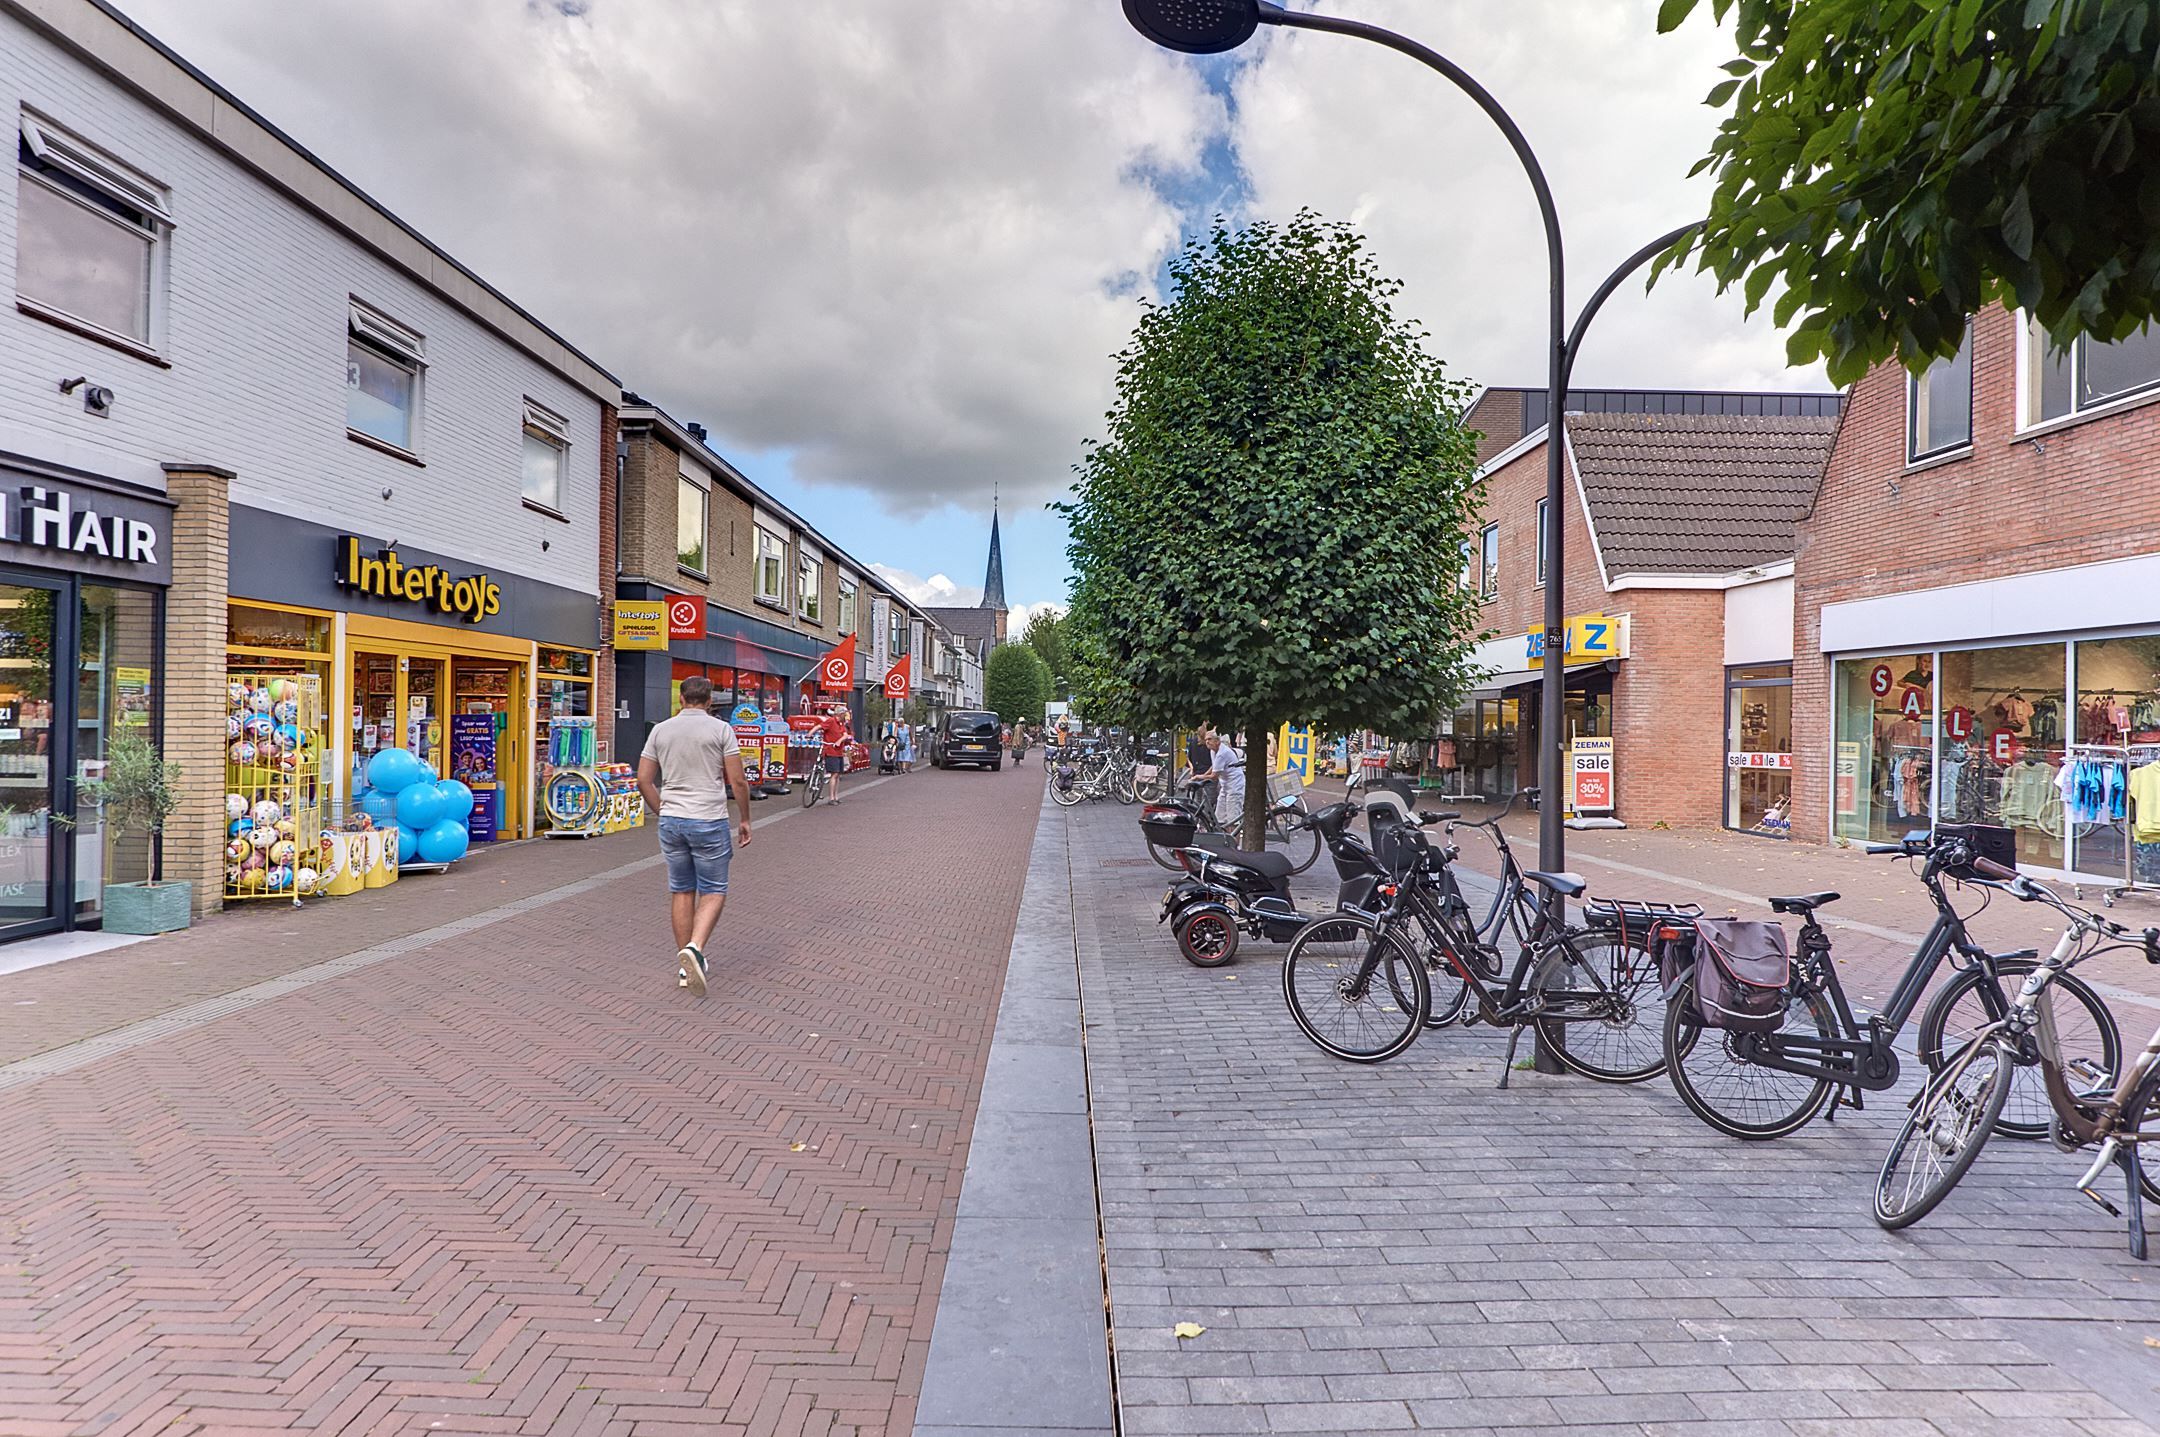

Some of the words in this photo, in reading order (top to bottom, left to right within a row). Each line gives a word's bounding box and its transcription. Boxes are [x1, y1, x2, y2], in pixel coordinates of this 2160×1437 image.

[32, 486, 158, 564] HAIR
[349, 537, 500, 623] Intertoys
[618, 610, 661, 621] Intertoys
[1585, 624, 1607, 650] Z
[825, 680, 847, 688] Kruidvat
[738, 738, 760, 747] CTIE!
[1575, 741, 1610, 749] ZEEMAN
[1576, 755, 1610, 769] sale
[1729, 754, 1747, 765] sale
[769, 765, 785, 774] 2+2
[1580, 783, 1605, 794] 30%
